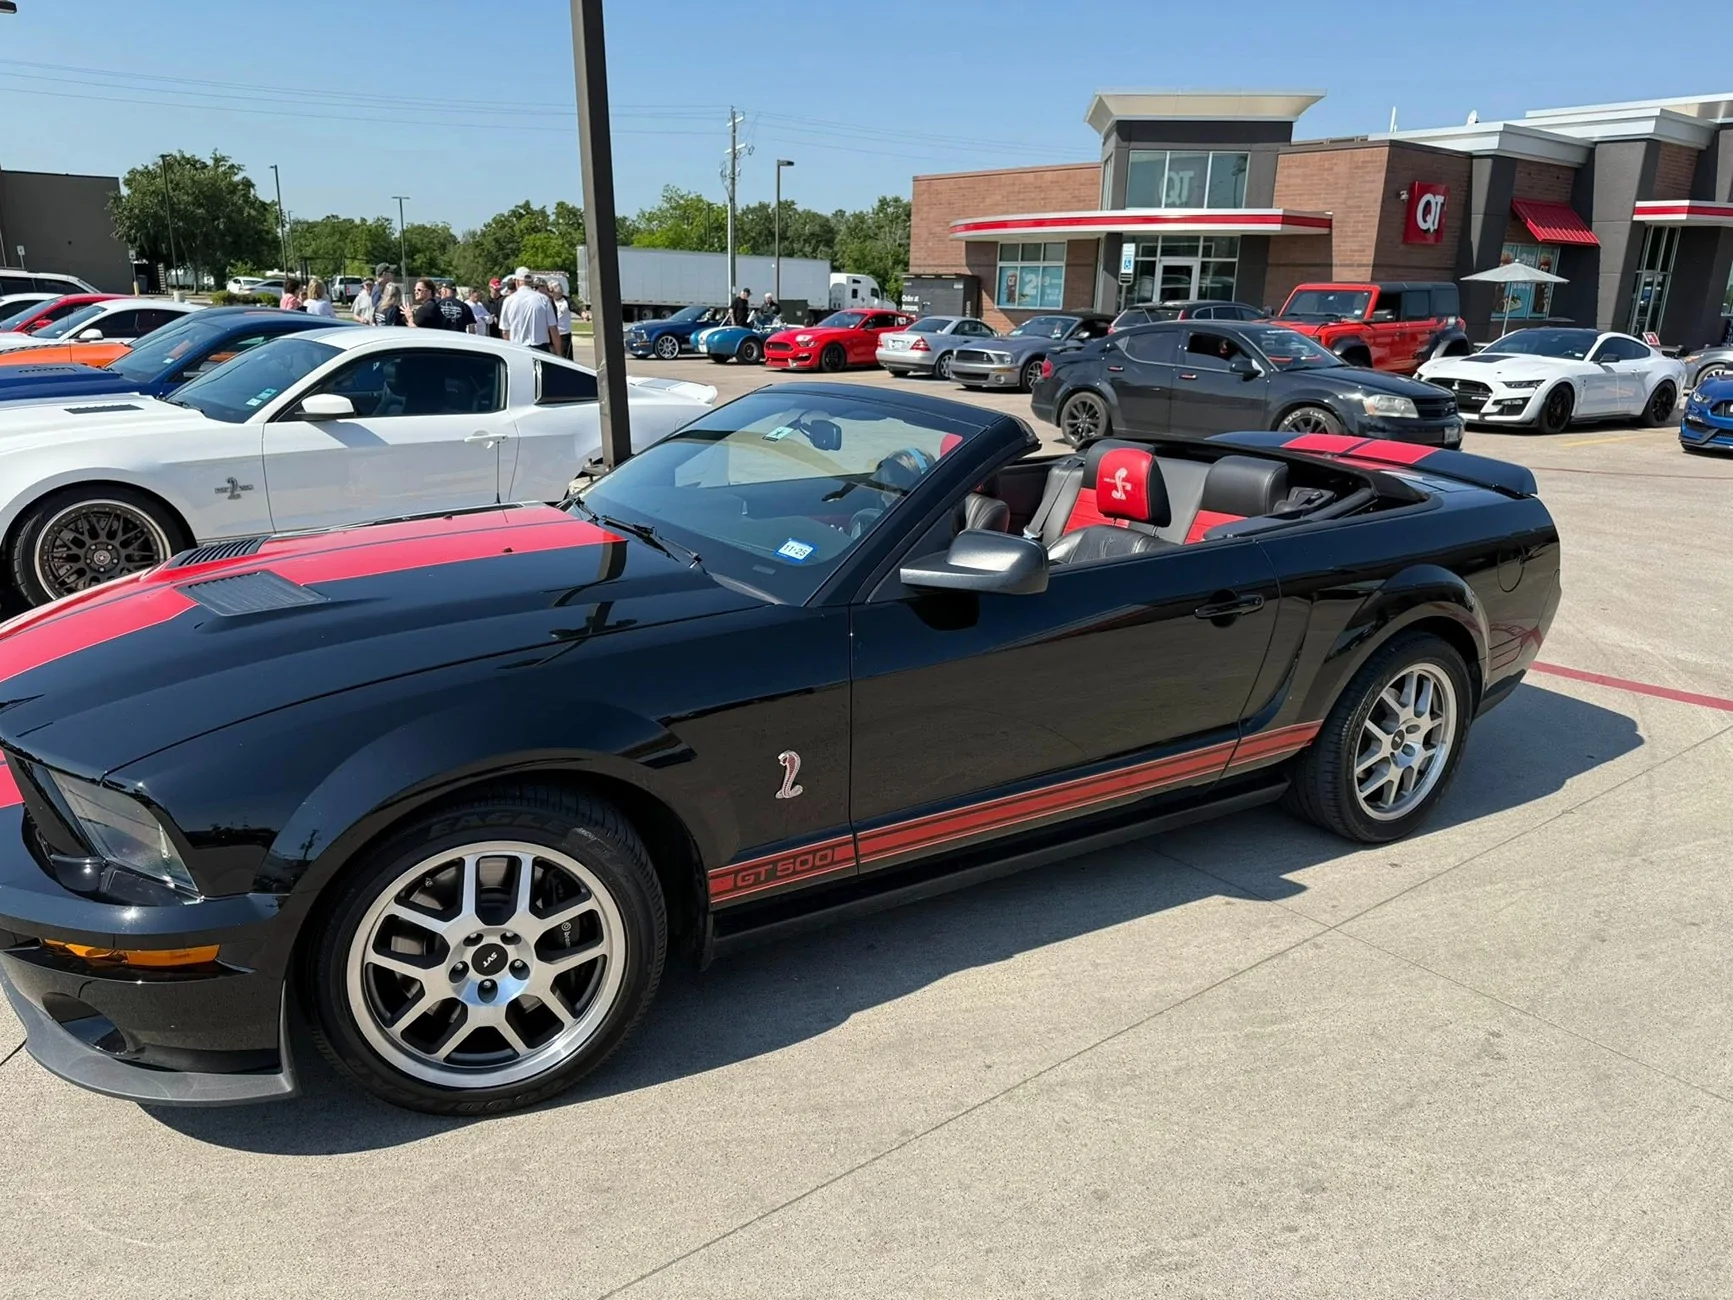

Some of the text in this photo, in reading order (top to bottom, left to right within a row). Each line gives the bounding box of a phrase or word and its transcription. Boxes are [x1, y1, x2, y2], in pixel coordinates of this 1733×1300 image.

[1159, 170, 1195, 206] QT
[1416, 192, 1445, 233] QT
[736, 849, 834, 887] GT 500
[482, 951, 498, 968] SVT
